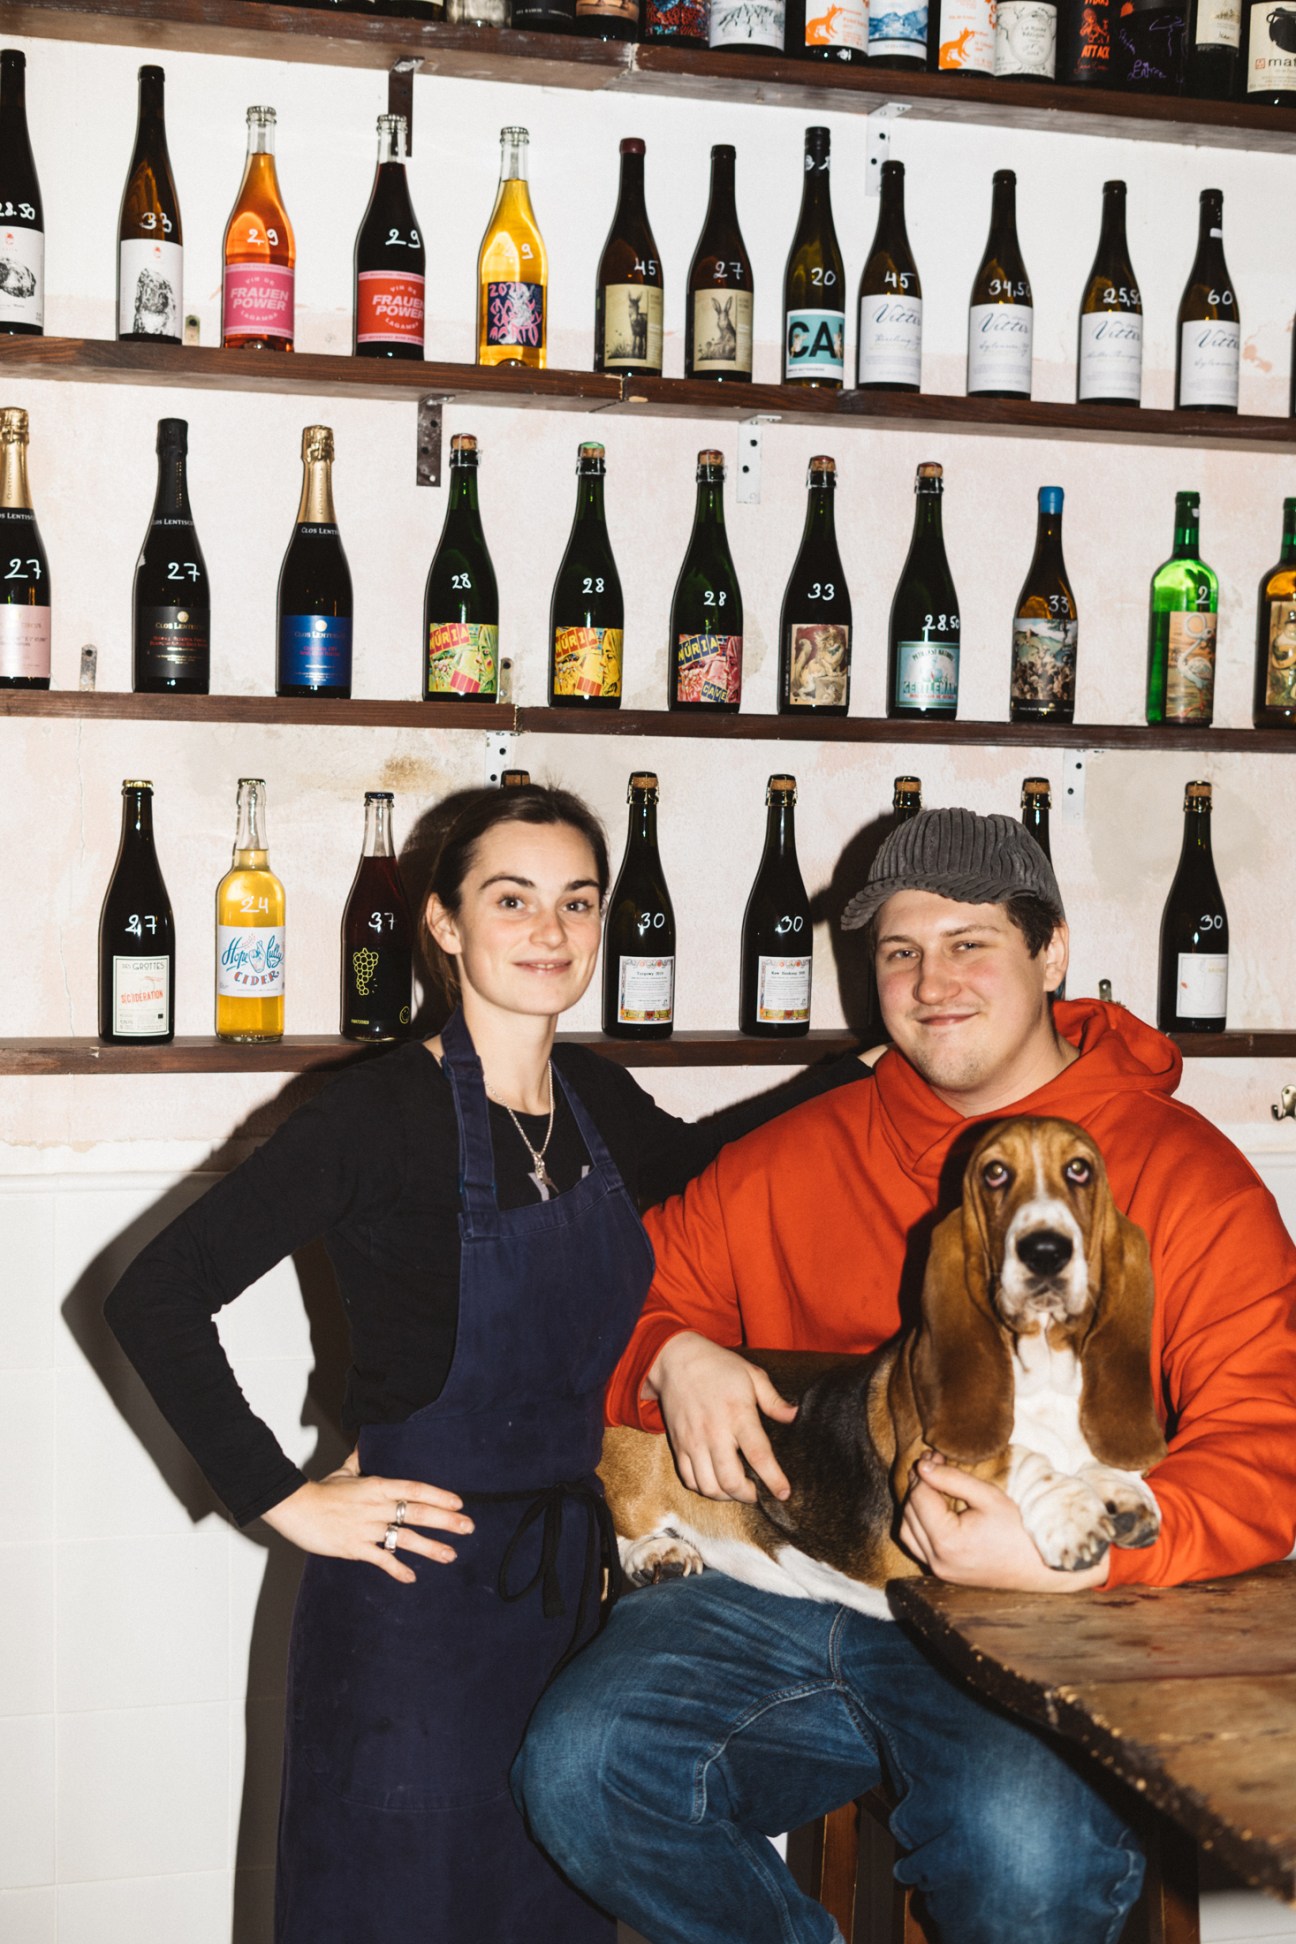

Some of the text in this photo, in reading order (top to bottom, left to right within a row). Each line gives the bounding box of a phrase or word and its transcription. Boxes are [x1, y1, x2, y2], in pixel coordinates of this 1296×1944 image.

[139, 212, 173, 233] 33
[246, 228, 279, 246] 29
[385, 228, 421, 248] 29
[634, 257, 659, 276] 45
[713, 261, 743, 280] 27
[811, 267, 837, 286] 20
[884, 270, 915, 289] 45
[230, 286, 290, 301] FRAUEN
[1207, 289, 1233, 305] 60
[232, 299, 286, 311] POWER
[4, 558, 42, 580] 27
[167, 562, 200, 582] 27
[451, 572, 472, 589] 28
[582, 577, 605, 594] 28
[703, 591, 727, 606] 28
[807, 583, 834, 601] 33
[1048, 595, 1068, 613] 33
[240, 895, 269, 913] 24
[125, 914, 157, 936] 27
[368, 911, 395, 931] 37
[637, 912, 665, 929] 30
[775, 915, 804, 933] 30
[1200, 914, 1223, 931] 30
[132, 962, 165, 971] GROTTES
[234, 970, 278, 986] CIDER
